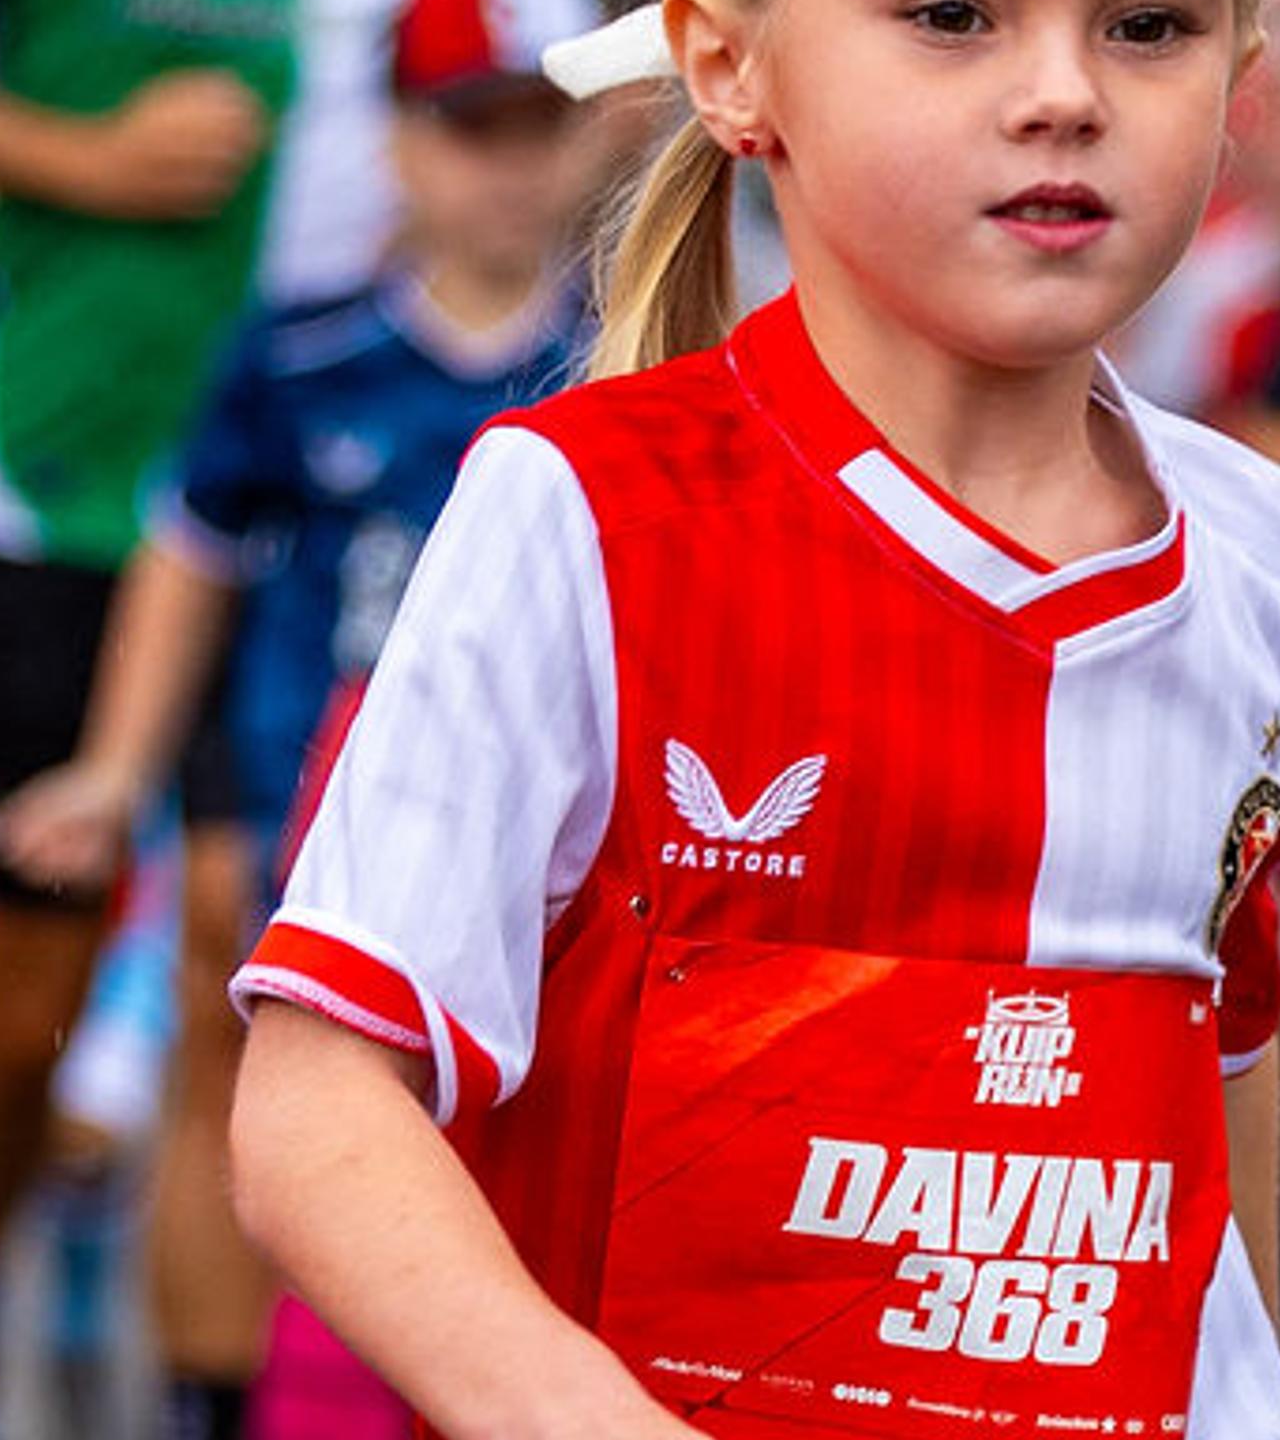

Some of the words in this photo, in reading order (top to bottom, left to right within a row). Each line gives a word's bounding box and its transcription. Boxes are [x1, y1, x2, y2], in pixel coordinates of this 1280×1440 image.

[661, 841, 806, 879] CASTORE
[974, 1022, 1076, 1066] KUIP
[973, 1064, 1068, 1107] RUN
[782, 1135, 1174, 1263] DAVINA
[878, 1254, 1119, 1367] 368
